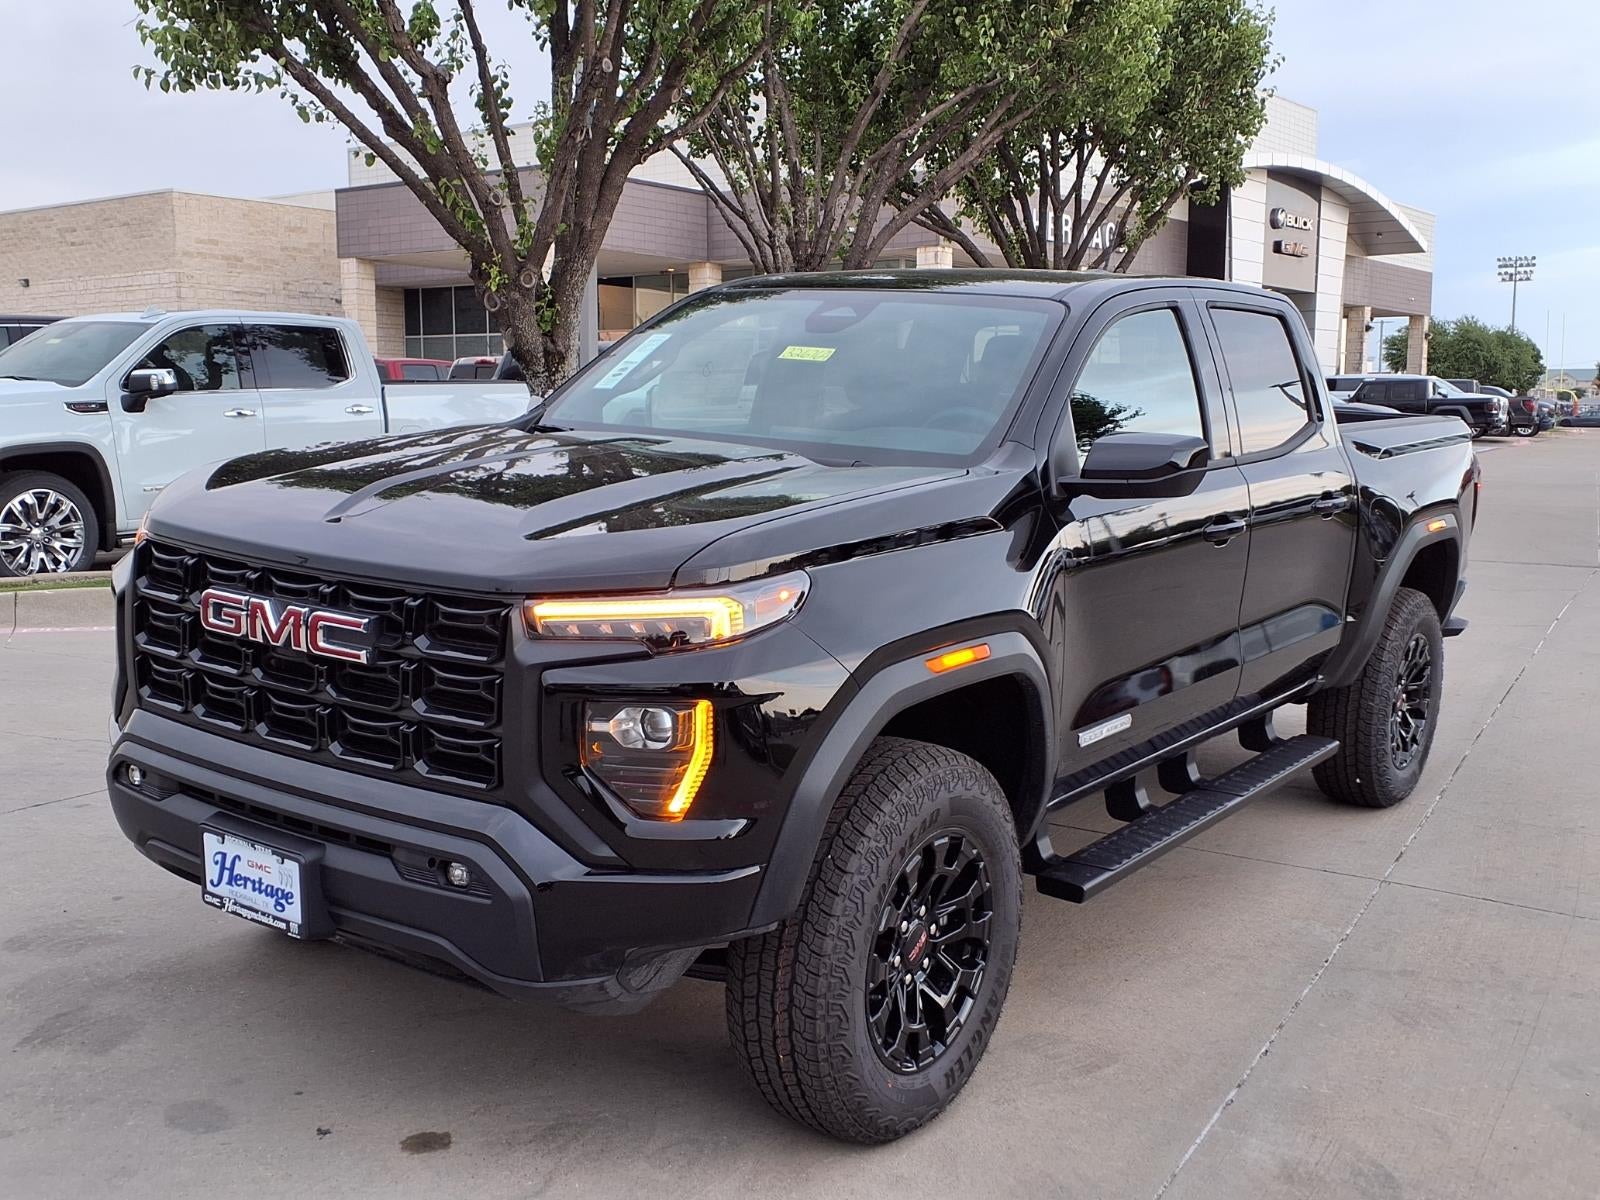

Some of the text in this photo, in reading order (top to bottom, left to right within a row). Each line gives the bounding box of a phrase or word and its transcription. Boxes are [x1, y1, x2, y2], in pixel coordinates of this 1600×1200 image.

[1286, 214, 1313, 230] BUICK
[200, 588, 369, 664] GMC
[209, 851, 294, 913] Heritage
[247, 860, 272, 874] GMC
